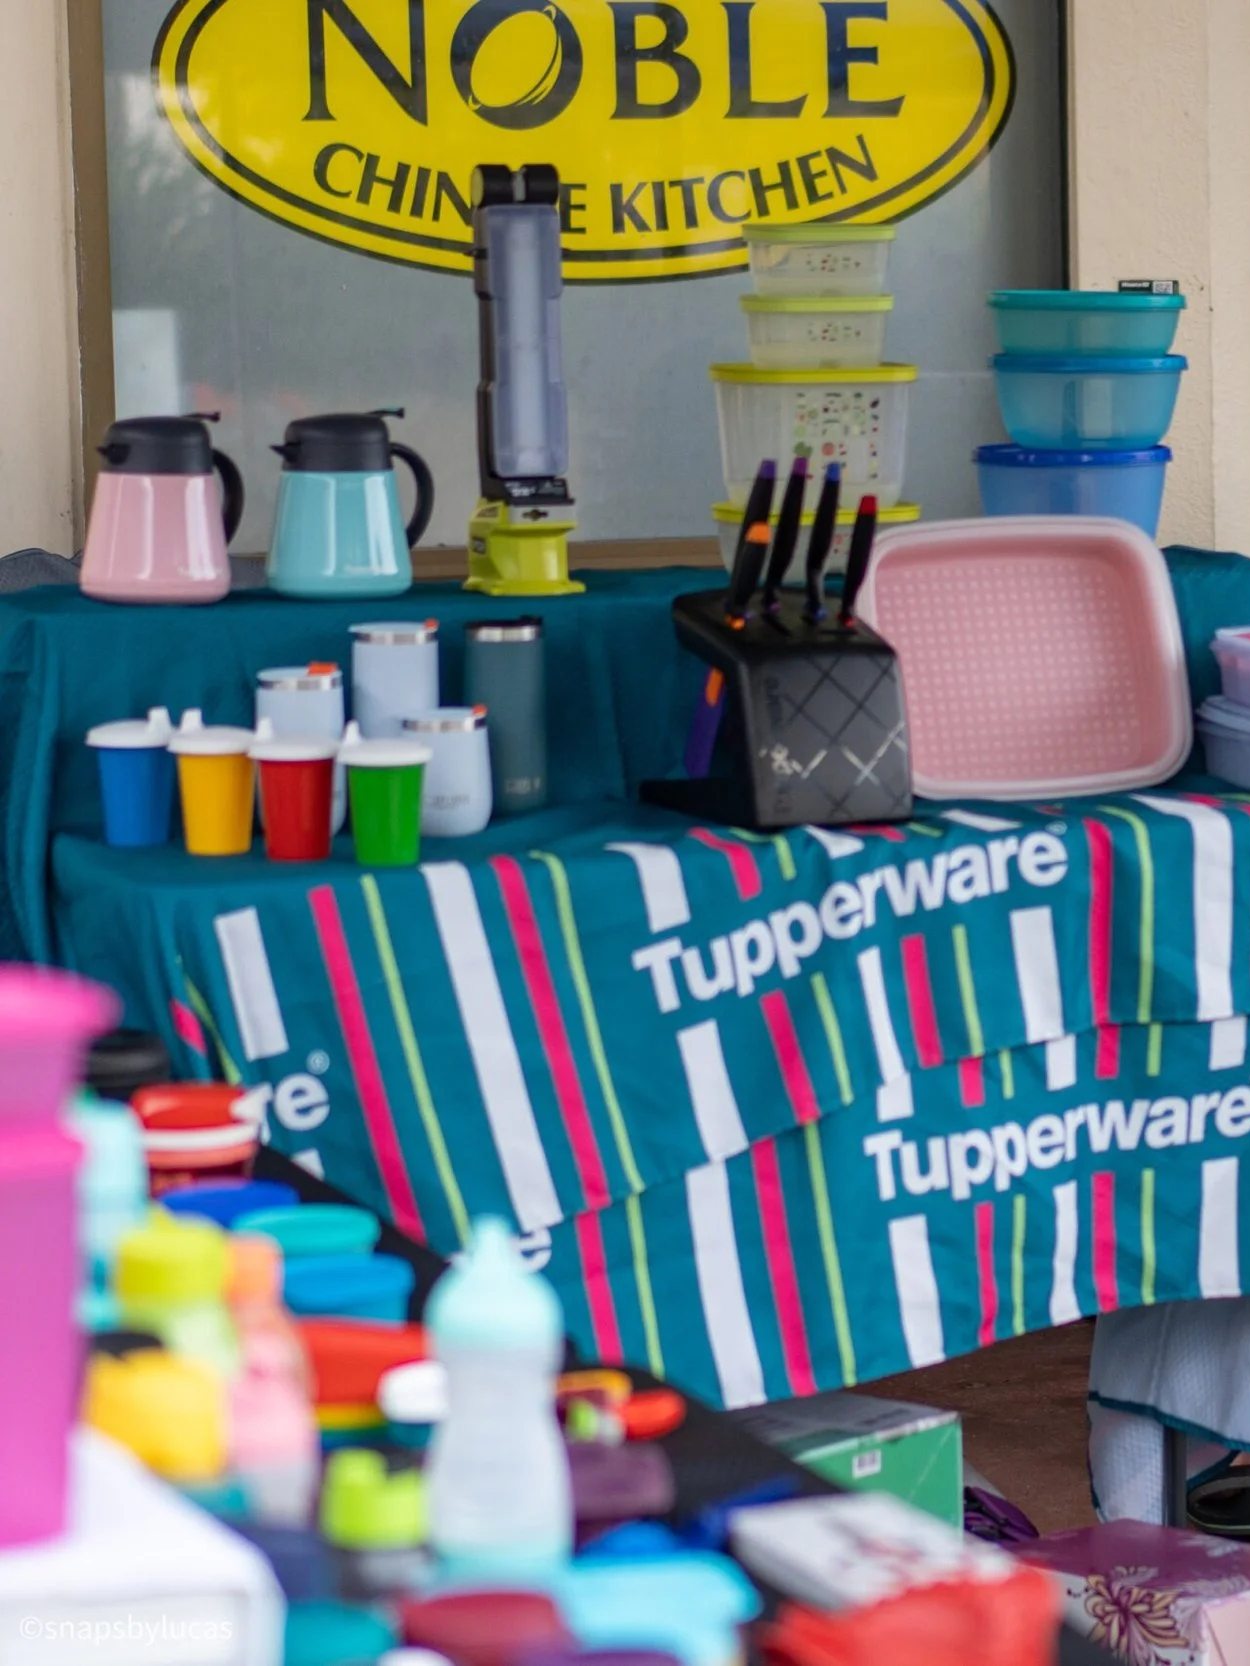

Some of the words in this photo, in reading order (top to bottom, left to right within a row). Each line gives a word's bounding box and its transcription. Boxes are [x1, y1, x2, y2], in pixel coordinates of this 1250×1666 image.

[301, 0, 906, 130] NOBLE
[313, 142, 587, 235] CHINE
[609, 133, 879, 234] KITCHEN
